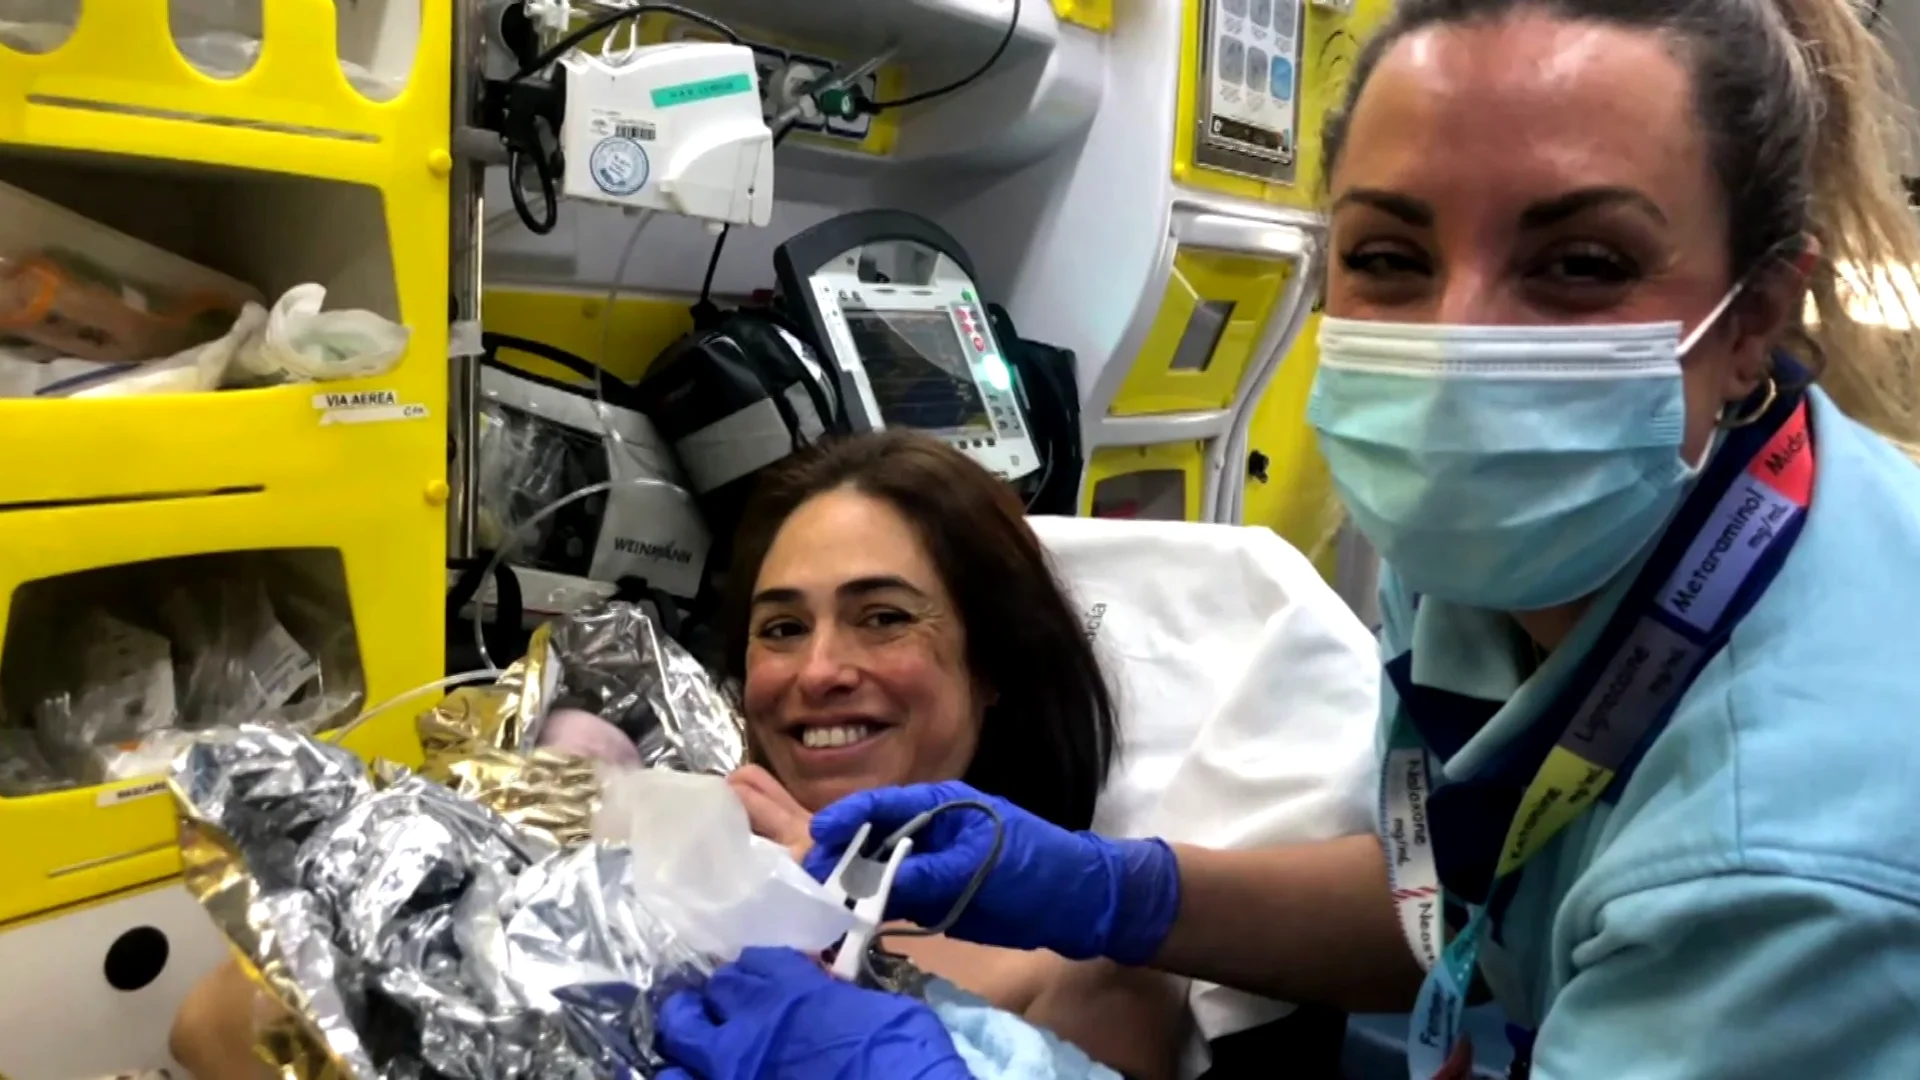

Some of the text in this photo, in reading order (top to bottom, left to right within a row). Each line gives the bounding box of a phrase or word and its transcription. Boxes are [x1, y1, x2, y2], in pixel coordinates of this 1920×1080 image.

[325, 391, 395, 407] VIA AEREA
[1669, 486, 1765, 614] Metaraminol
[1573, 645, 1649, 743] Lignocaine
[1406, 758, 1427, 847] Naloxone
